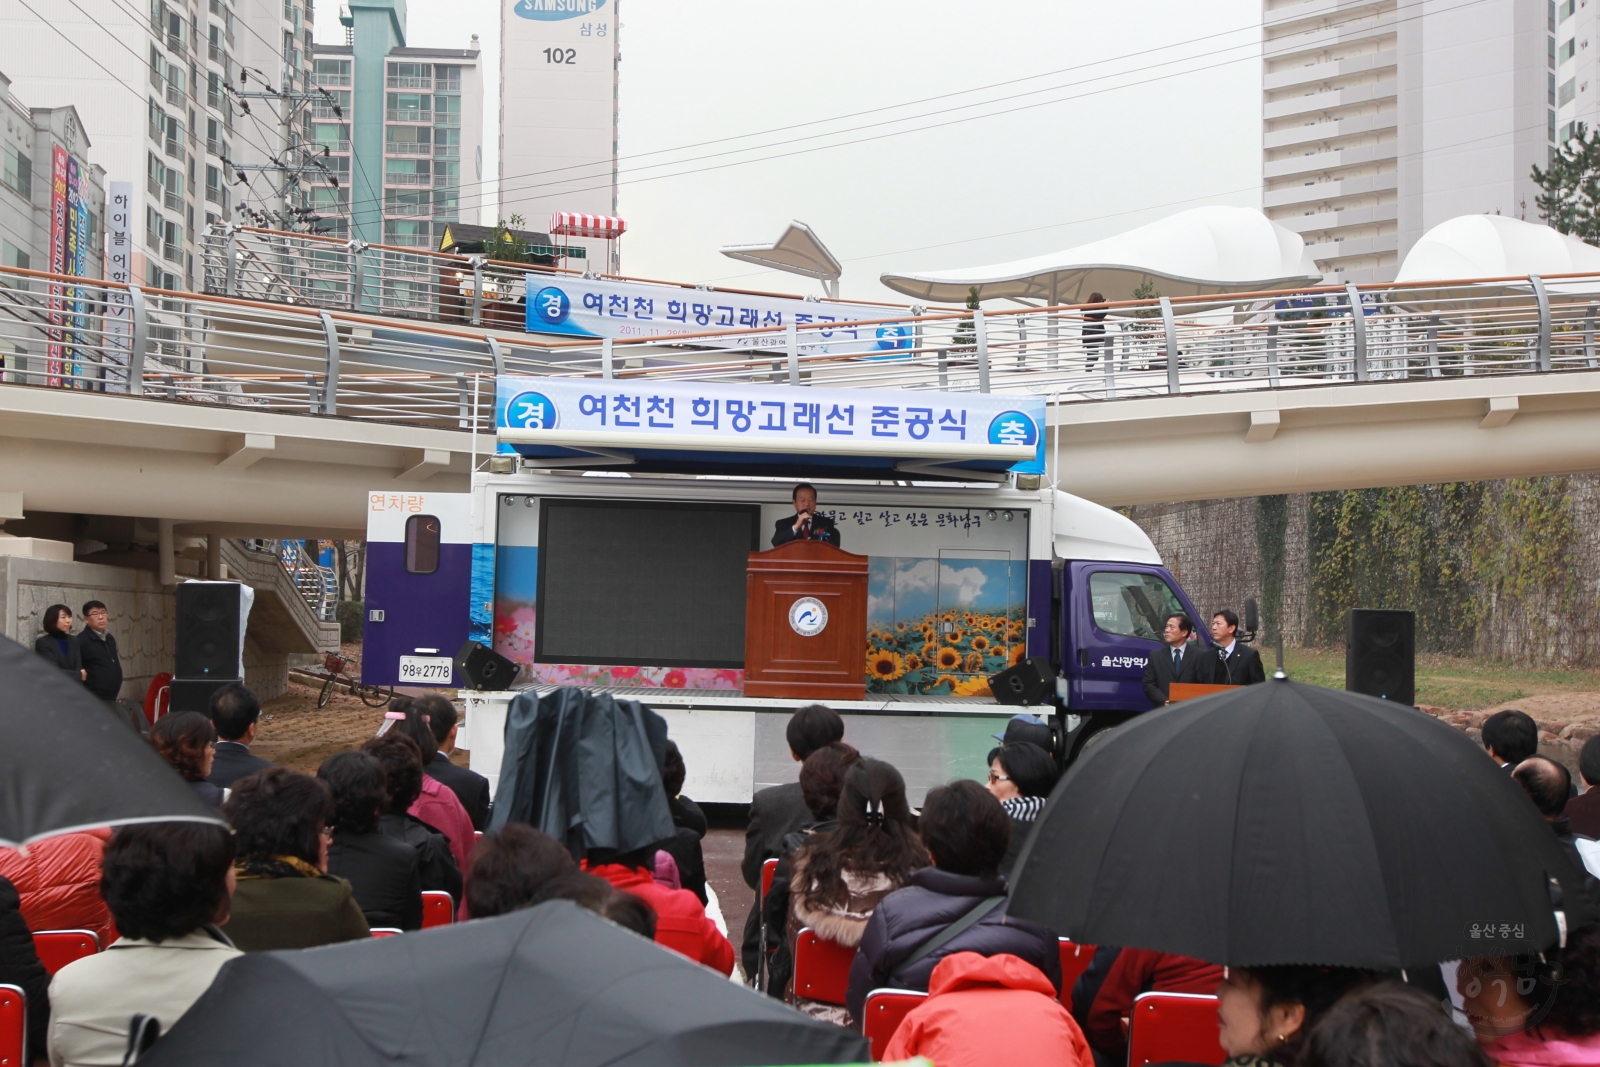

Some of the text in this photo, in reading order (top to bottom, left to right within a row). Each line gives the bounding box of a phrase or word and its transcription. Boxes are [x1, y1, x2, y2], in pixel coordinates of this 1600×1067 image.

[524, 0, 597, 12] SAMSUNG
[580, 22, 607, 37] 삼성
[543, 47, 576, 64] 102
[542, 293, 562, 317] 경
[582, 292, 654, 321] 여천천
[666, 299, 782, 332] 희망고래선
[517, 401, 545, 429] 경
[578, 394, 967, 440] 여천천 희망고래선 준공식
[997, 420, 1028, 446] 축
[370, 493, 425, 513] 연차량
[853, 511, 873, 526] 싶고
[879, 511, 901, 527] 살고
[906, 512, 928, 527] 싶은
[402, 664, 450, 678] 98우2778
